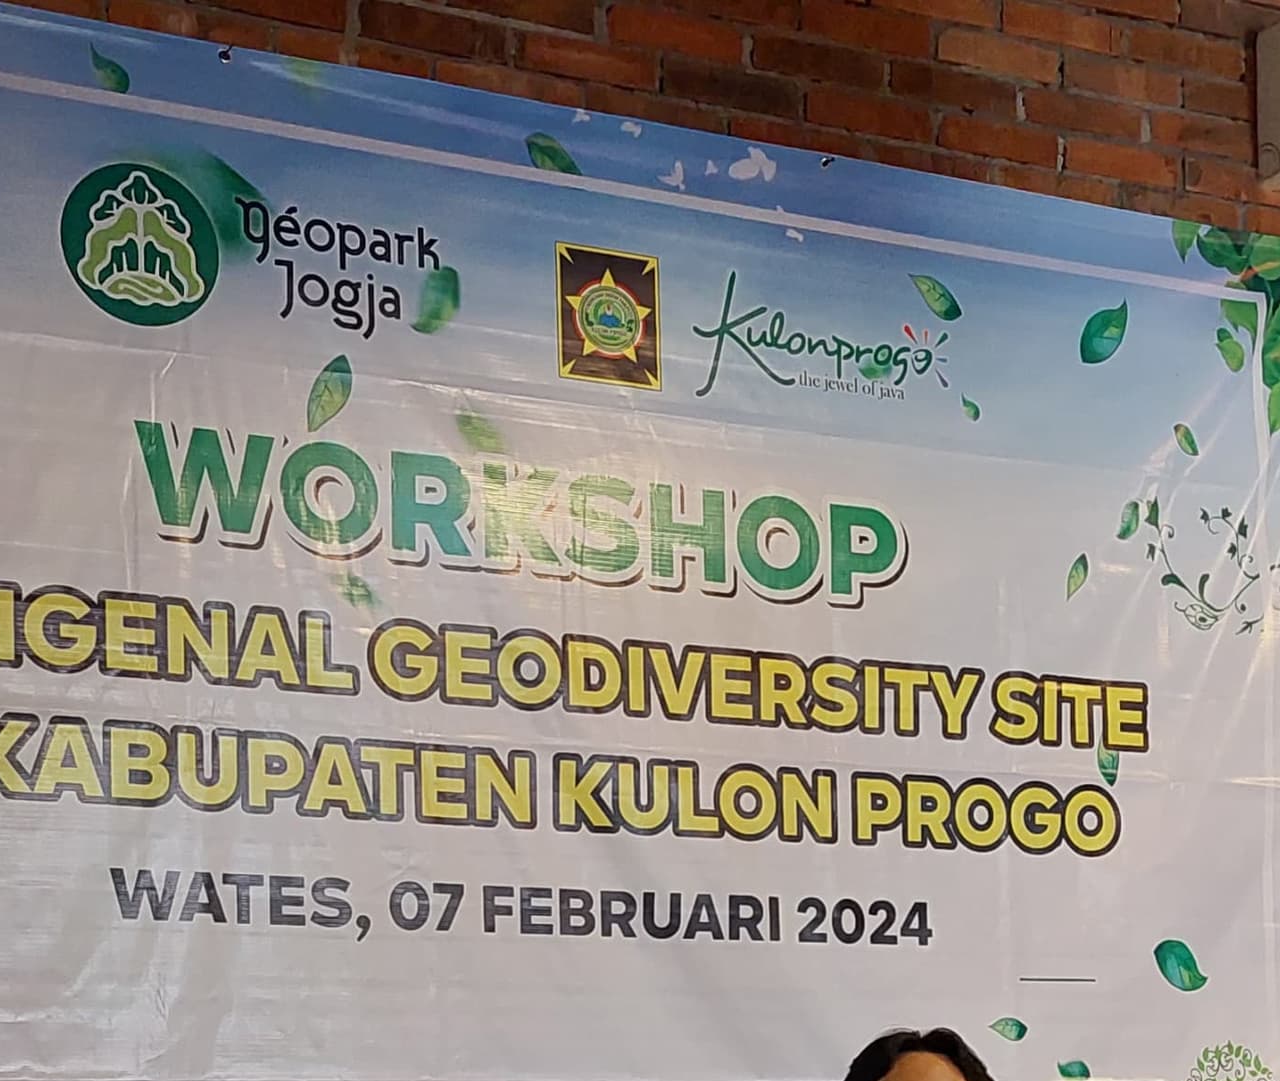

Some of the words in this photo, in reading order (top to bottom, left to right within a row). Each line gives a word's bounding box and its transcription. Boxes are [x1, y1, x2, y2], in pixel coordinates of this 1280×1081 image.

[235, 196, 440, 271] géopark
[274, 259, 401, 339] Jogja
[692, 271, 933, 396] Kulonprogo
[800, 370, 821, 388] the
[823, 373, 858, 393] jewel
[862, 380, 878, 396] of
[878, 381, 905, 400] java
[134, 418, 908, 608] WORKSHOP
[368, 620, 985, 740] GEODIVERSITY
[990, 672, 1149, 752] SITE
[553, 754, 838, 844] KULON
[852, 771, 1122, 856] PROGO
[109, 867, 372, 943] WATES,
[389, 882, 465, 932] 07
[483, 886, 781, 942] FEBRUARI
[797, 897, 933, 947] 2024
